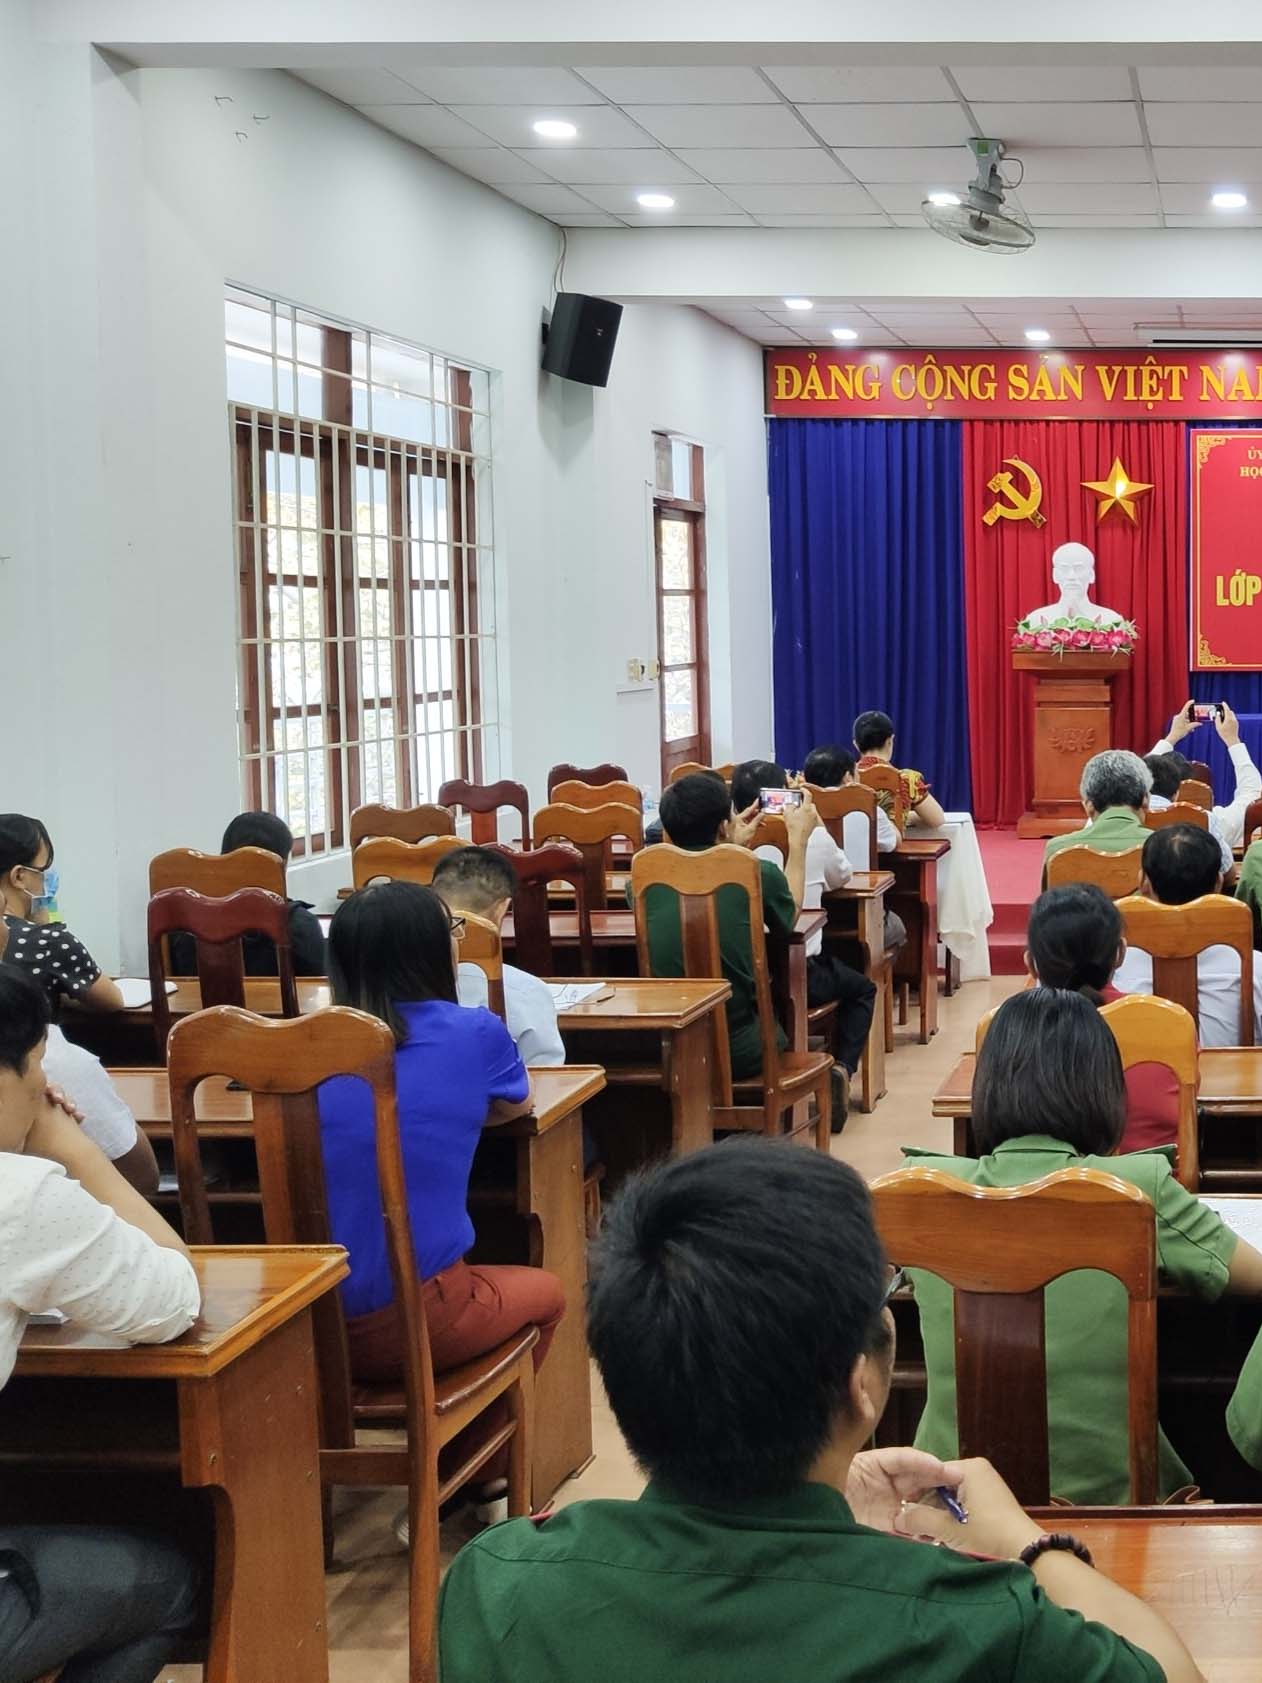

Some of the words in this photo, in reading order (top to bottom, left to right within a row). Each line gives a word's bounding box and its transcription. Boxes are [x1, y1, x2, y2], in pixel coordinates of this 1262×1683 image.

[774, 353, 881, 401] ĐẢNG
[891, 354, 997, 410] CỘNG
[1007, 354, 1085, 401] SẢN
[1096, 356, 1188, 410] VIỆT
[1216, 569, 1262, 606] LỚP
